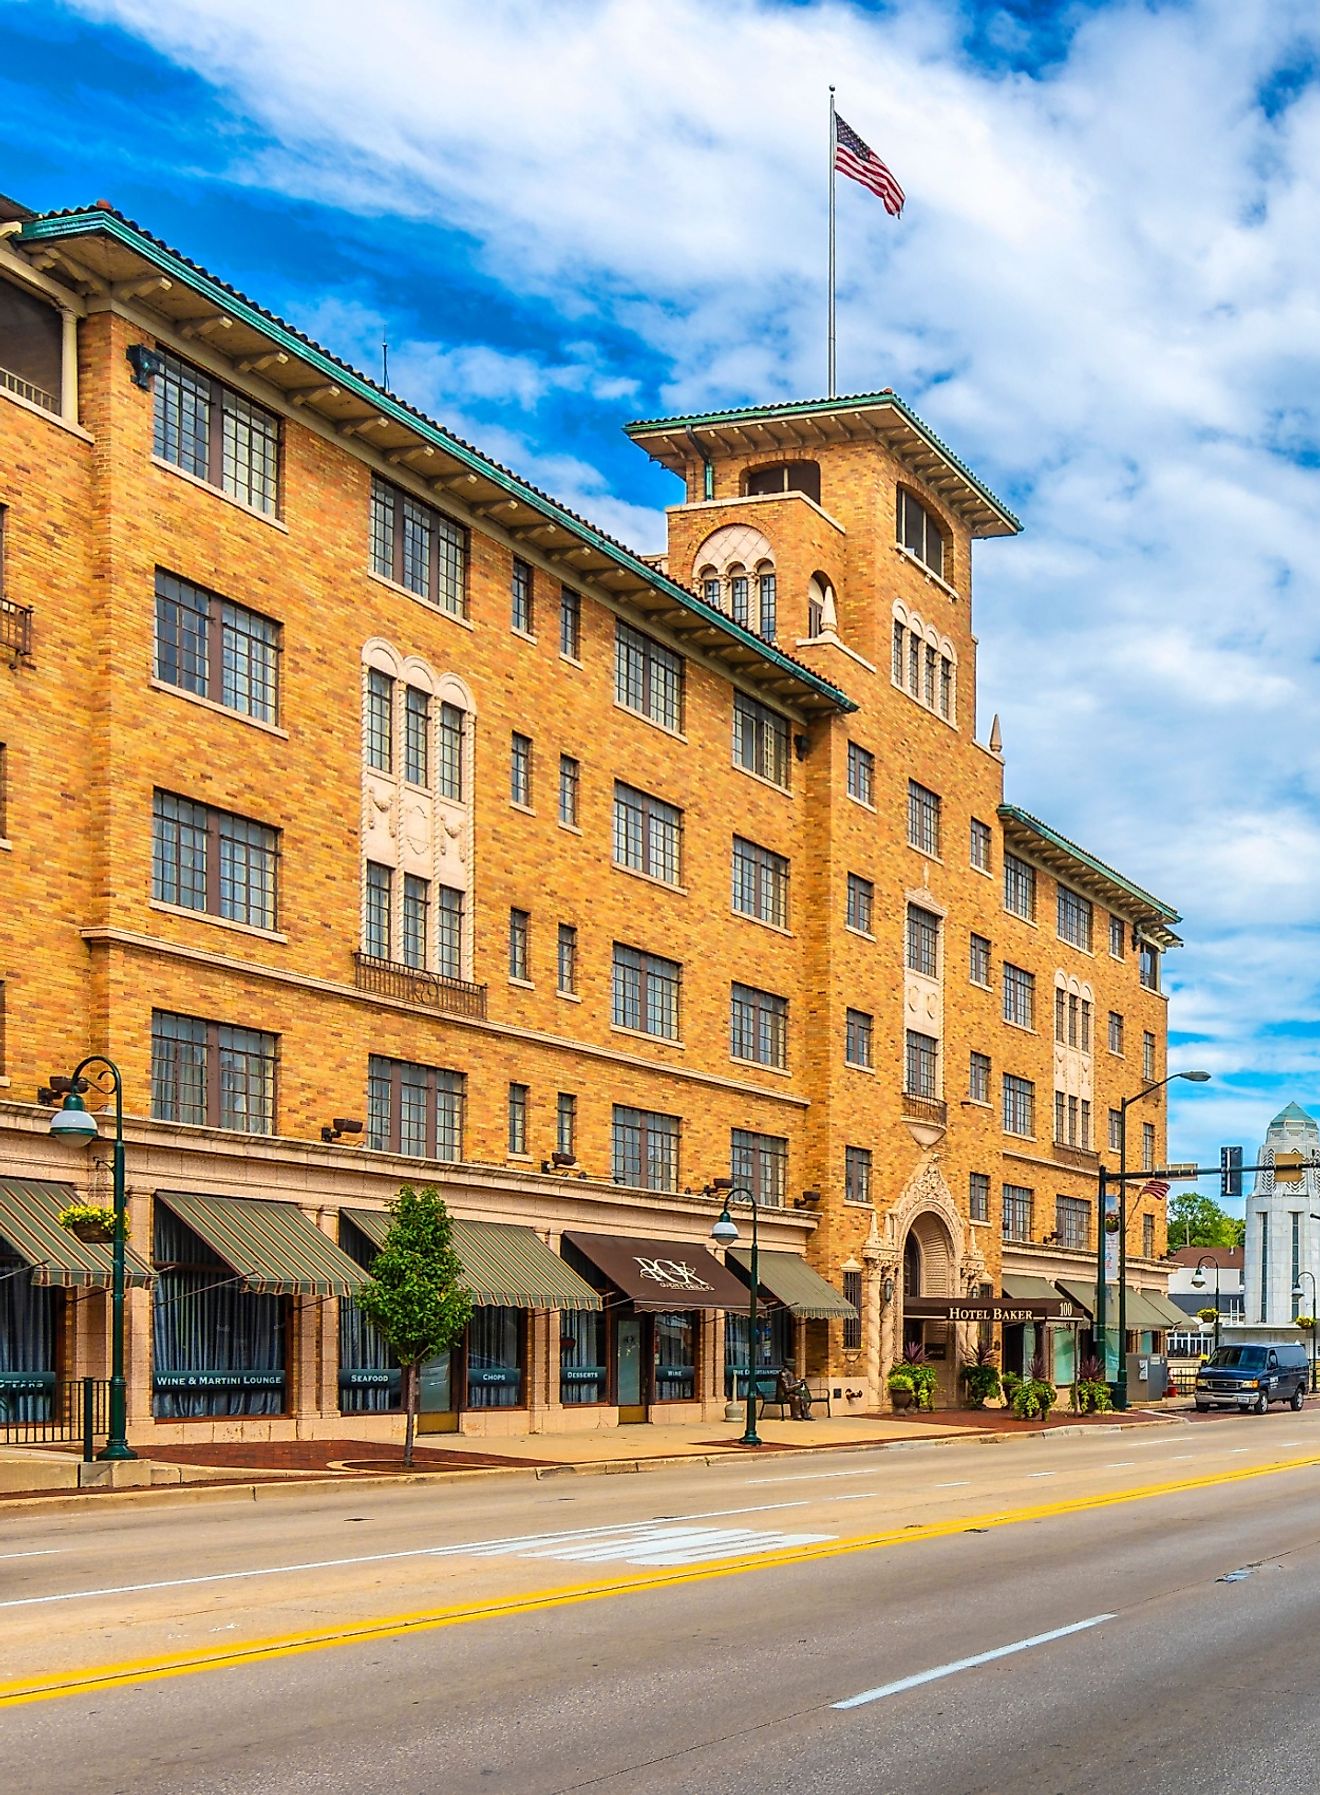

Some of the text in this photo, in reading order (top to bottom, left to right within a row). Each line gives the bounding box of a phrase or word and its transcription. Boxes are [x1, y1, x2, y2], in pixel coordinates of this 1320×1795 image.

[949, 1307, 1033, 1320] HOTEL BAKER
[1059, 1302, 1073, 1317] 100
[351, 1374, 389, 1383] SEAFOOD
[482, 1373, 506, 1381] CHOPS
[567, 1371, 599, 1379] DESSERTS
[157, 1376, 281, 1386] WINE & MARTINI LOUNGE
